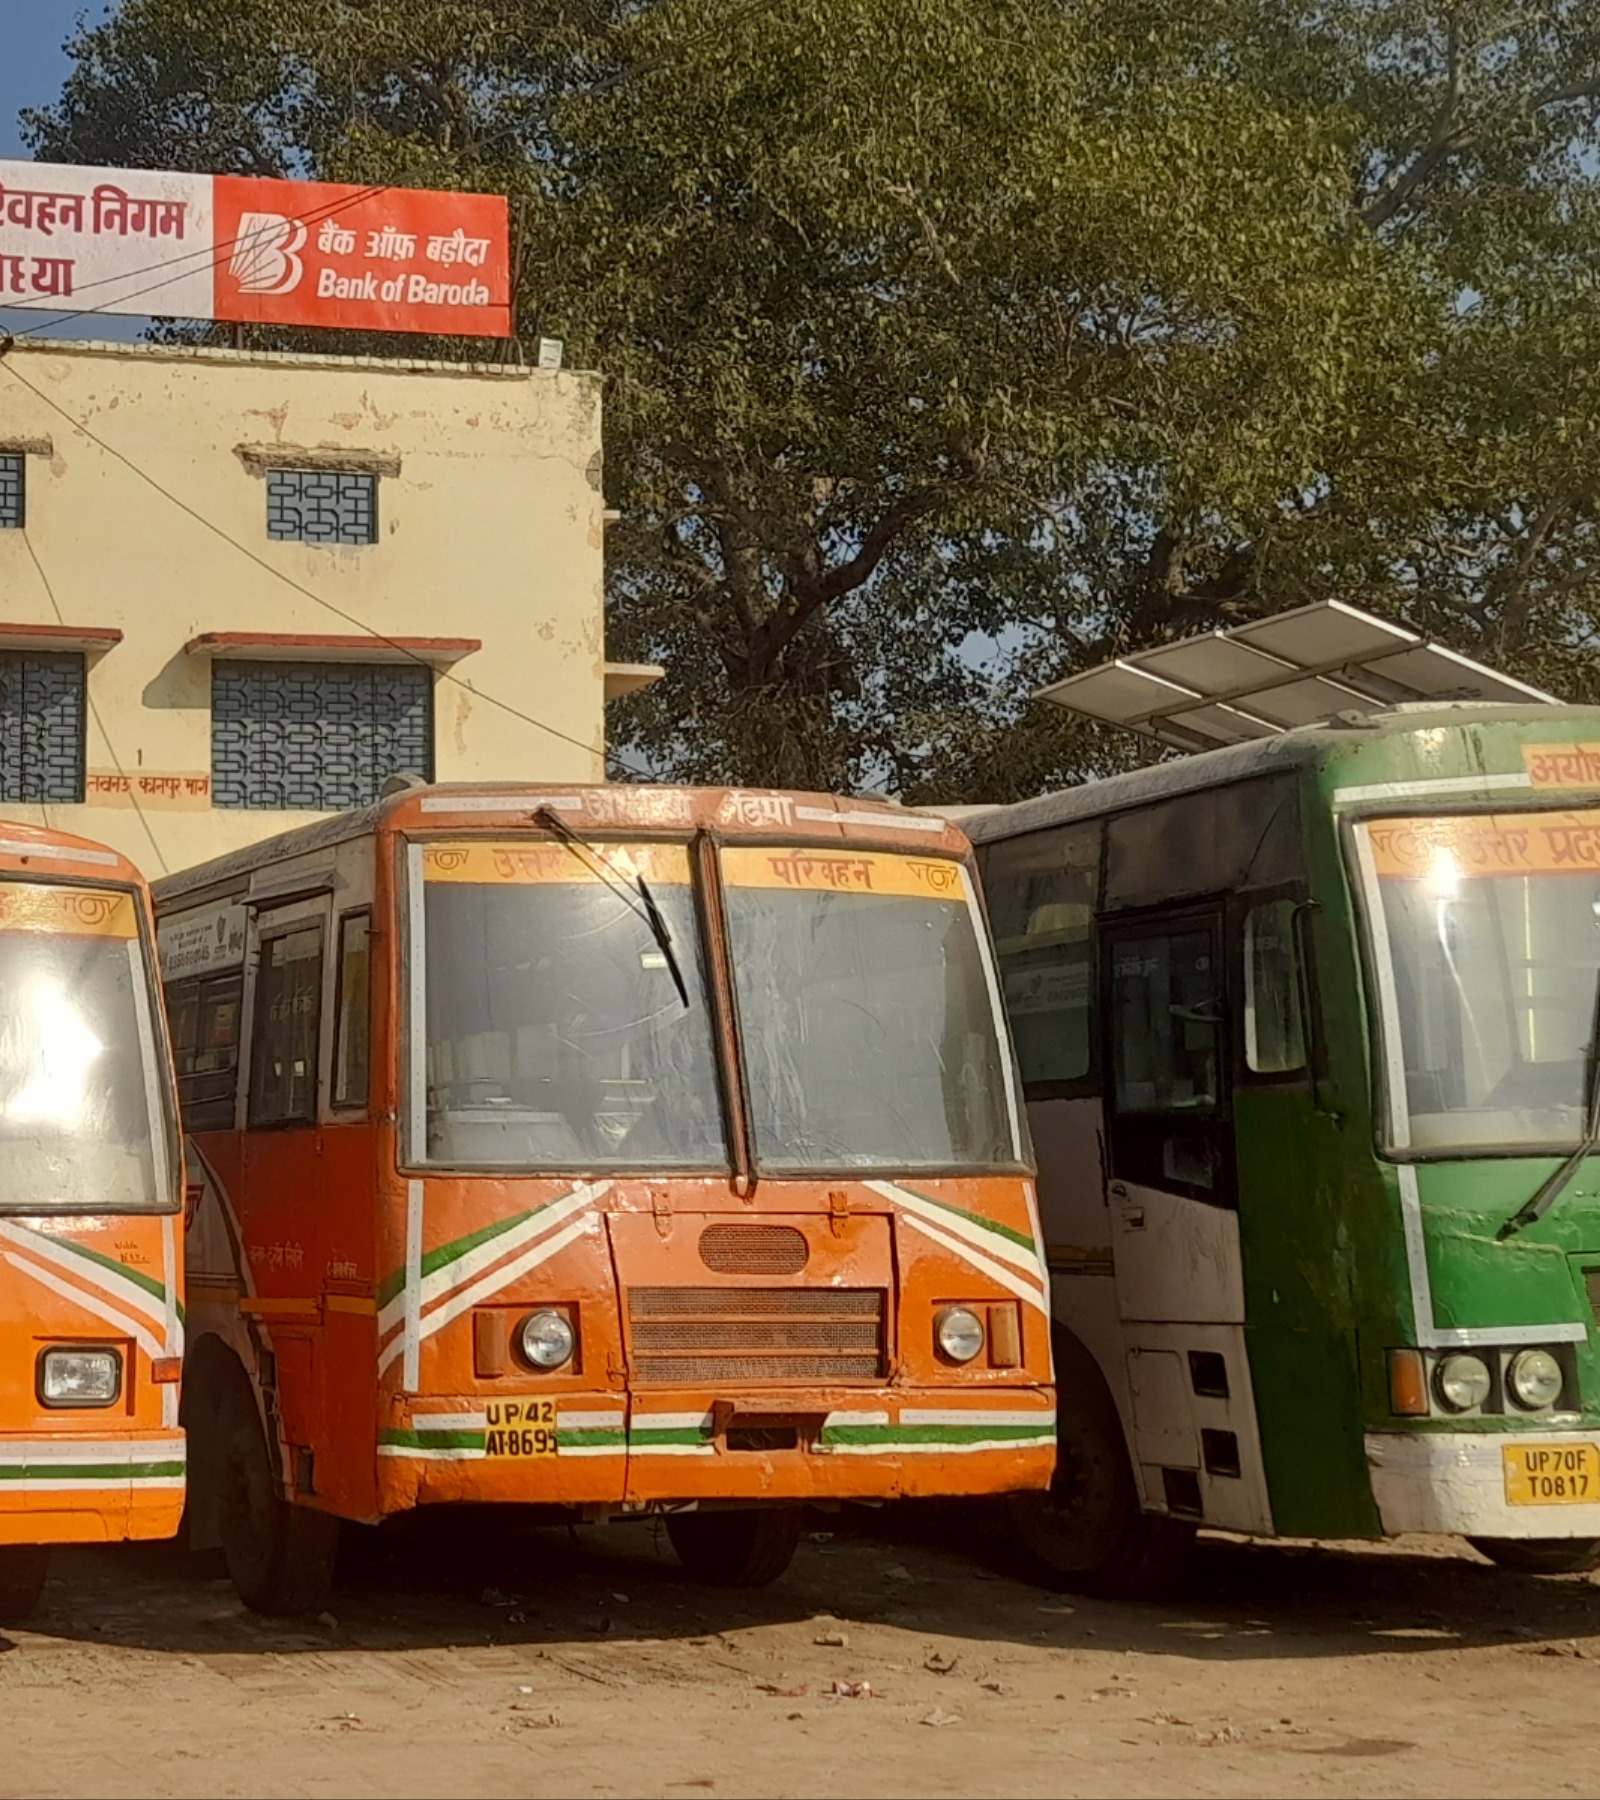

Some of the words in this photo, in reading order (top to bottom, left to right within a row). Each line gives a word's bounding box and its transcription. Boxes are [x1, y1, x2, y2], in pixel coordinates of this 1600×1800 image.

[91, 184, 188, 239] निगम
[317, 218, 357, 255] बैंक
[425, 228, 492, 268] बड़ौदा
[317, 268, 379, 300] Bank
[381, 274, 406, 302] of
[407, 275, 489, 305] Baroda
[137, 749, 143, 767] 1
[1539, 813, 1600, 867] प्रदे
[767, 850, 875, 889] परिवहन
[1525, 1450, 1586, 1472] UP70F
[1528, 1475, 1589, 1498] T0817
